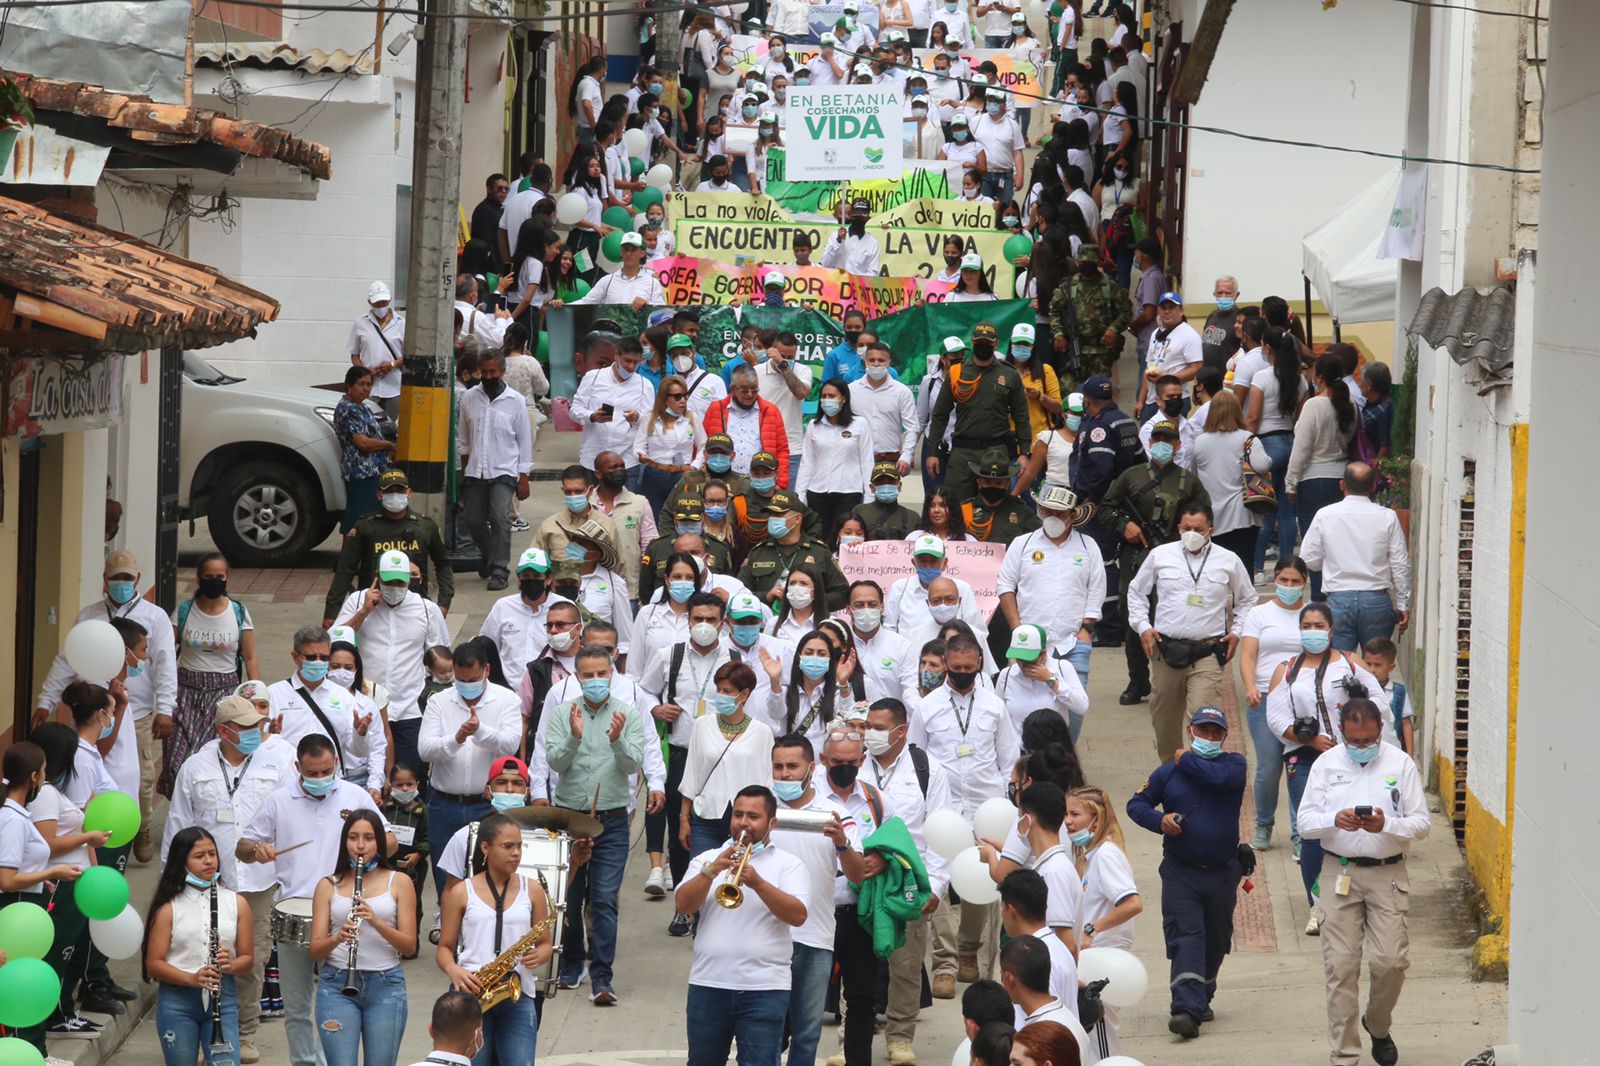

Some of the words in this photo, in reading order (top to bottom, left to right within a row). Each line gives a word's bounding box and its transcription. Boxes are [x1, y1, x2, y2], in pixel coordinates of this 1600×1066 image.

[791, 95, 813, 107] EN
[821, 93, 898, 107] BETANIA
[807, 106, 879, 115] COSECHAMOS
[804, 114, 885, 140] VIDA
[765, 158, 782, 182] EN
[717, 203, 737, 219] no
[951, 205, 992, 229] vida
[885, 232, 913, 254] LA
[29, 363, 58, 420] La
[61, 372, 95, 419] casa
[374, 539, 420, 553] POLICIA
[185, 629, 232, 642] MOMENT
